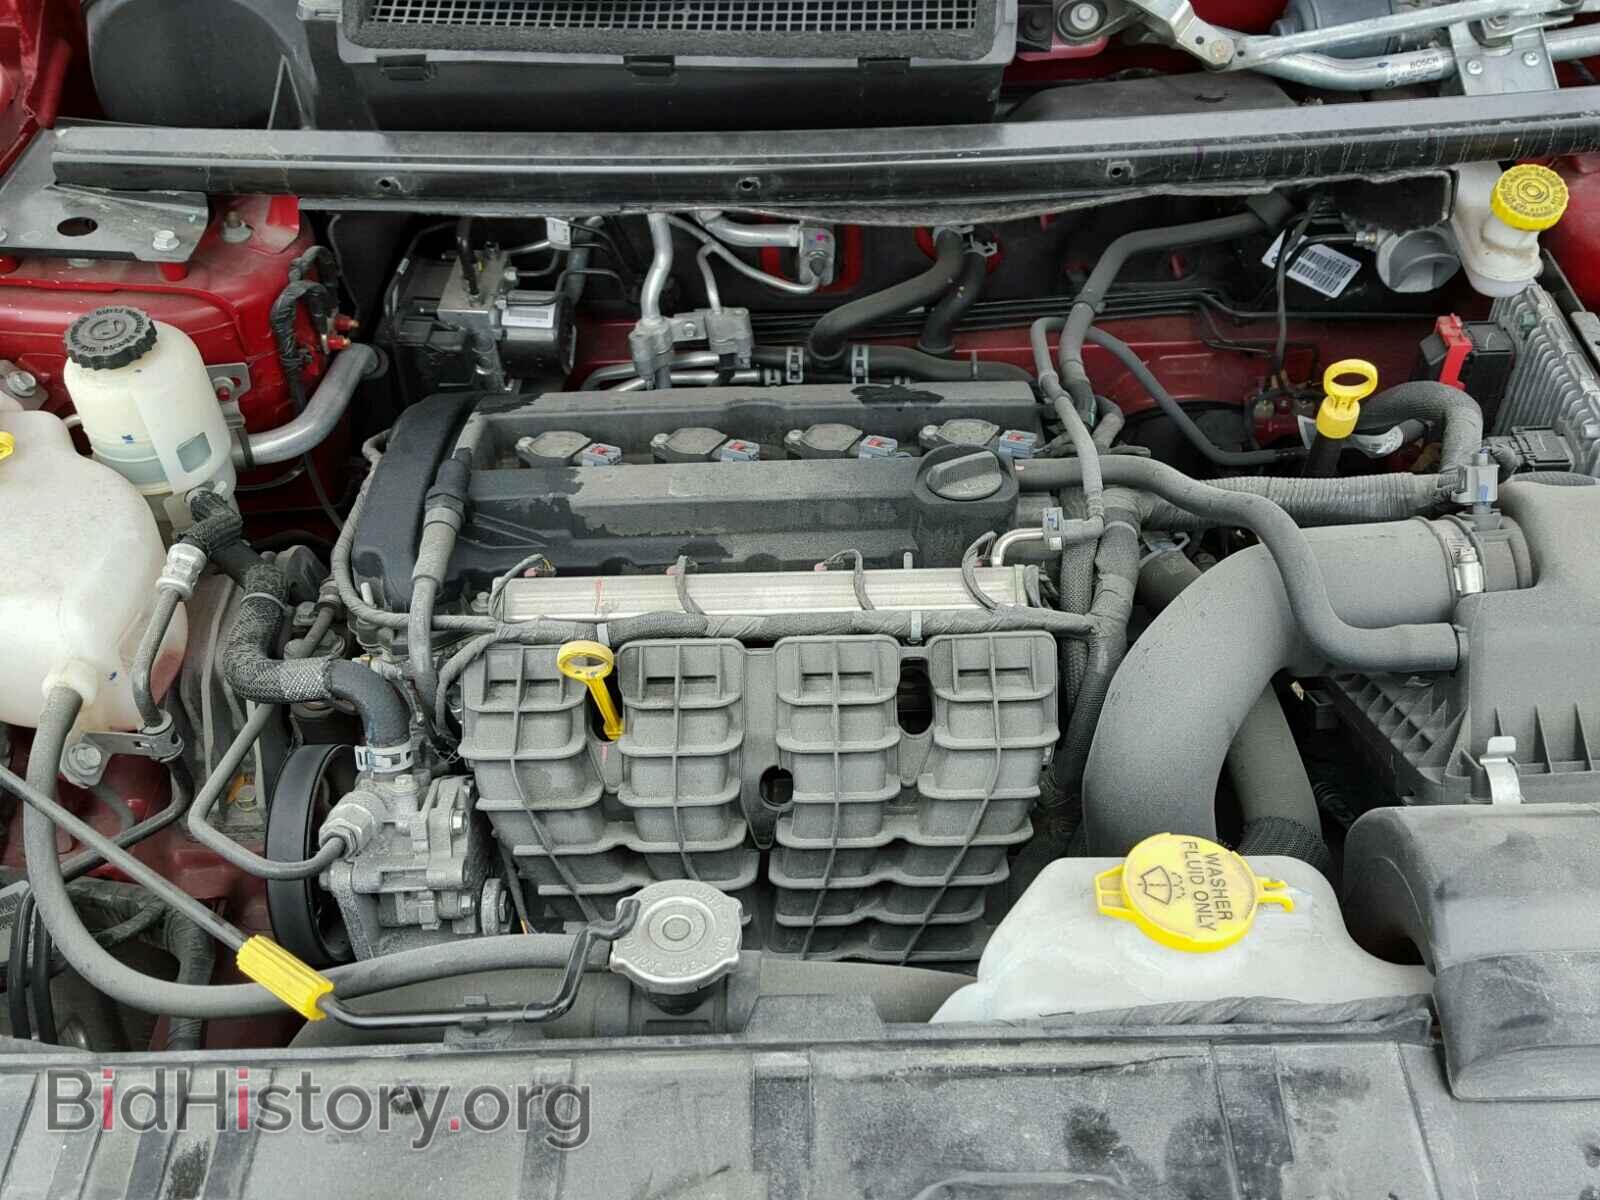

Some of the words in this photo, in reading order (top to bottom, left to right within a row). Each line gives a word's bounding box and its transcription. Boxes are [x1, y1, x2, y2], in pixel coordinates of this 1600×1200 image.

[1183, 841, 1205, 885] FLUID
[1204, 852, 1233, 921] WASHER
[1193, 890, 1217, 931] ONLY
